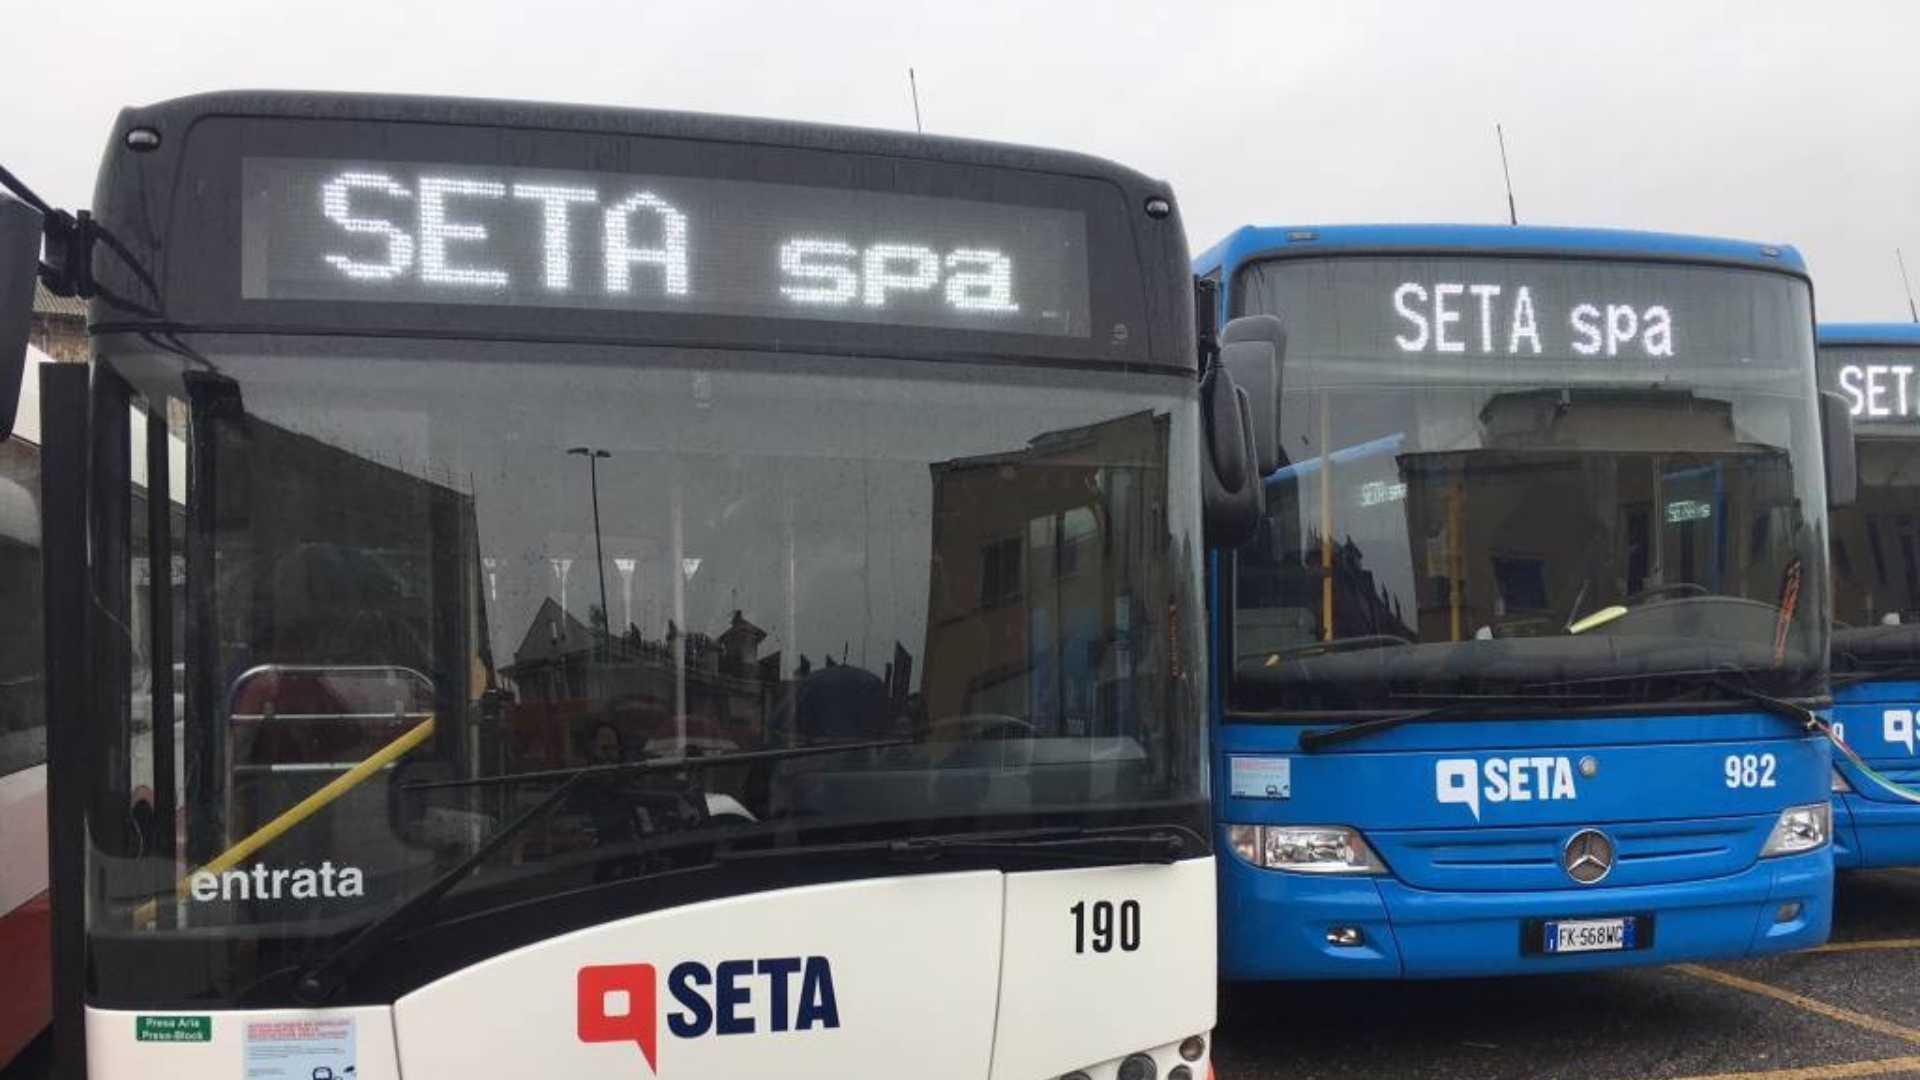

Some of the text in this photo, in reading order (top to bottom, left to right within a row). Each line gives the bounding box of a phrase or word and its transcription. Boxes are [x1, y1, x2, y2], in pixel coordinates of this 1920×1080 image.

[322, 171, 1019, 313] SETA spa
[1394, 282, 1674, 356] SETA spa
[1839, 365, 1920, 416] SET
[1484, 756, 1576, 802] SETA
[1725, 753, 1776, 788] 982
[190, 861, 365, 902] entrata
[1070, 899, 1141, 953] 190
[667, 956, 840, 1039] SETA
